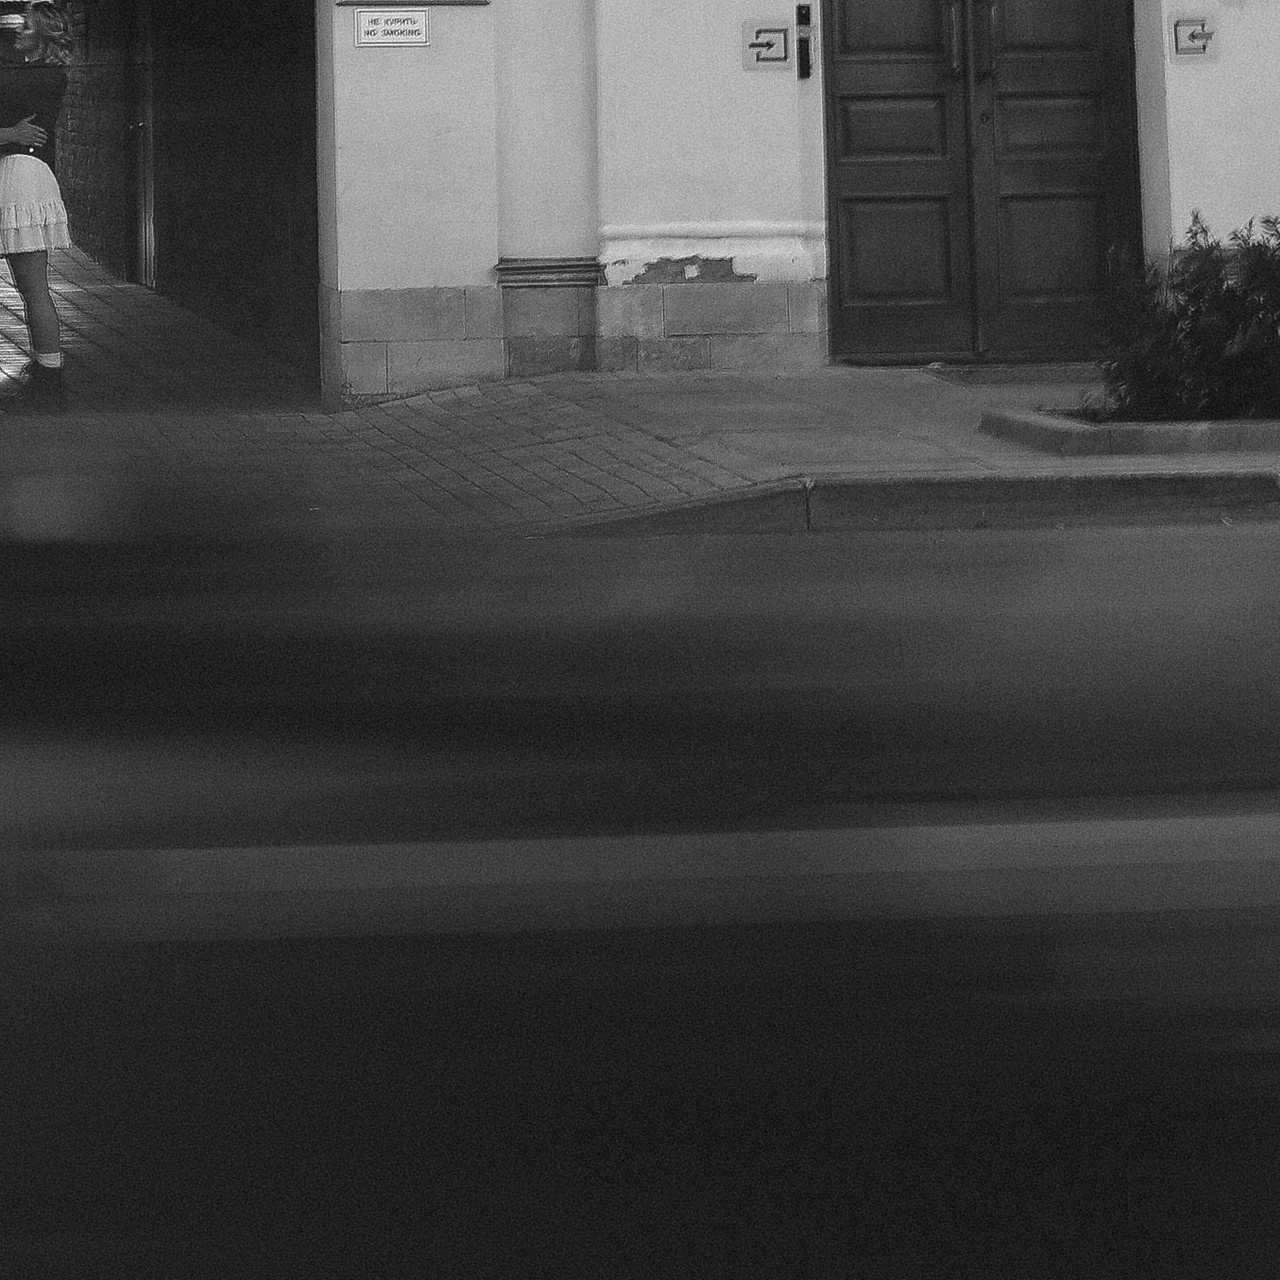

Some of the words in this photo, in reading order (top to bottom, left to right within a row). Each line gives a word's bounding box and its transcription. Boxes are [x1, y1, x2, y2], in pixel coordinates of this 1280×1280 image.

[383, 17, 419, 27] КУРИТЬ
[363, 28, 378, 38] NO
[381, 28, 422, 38] SMOKING
